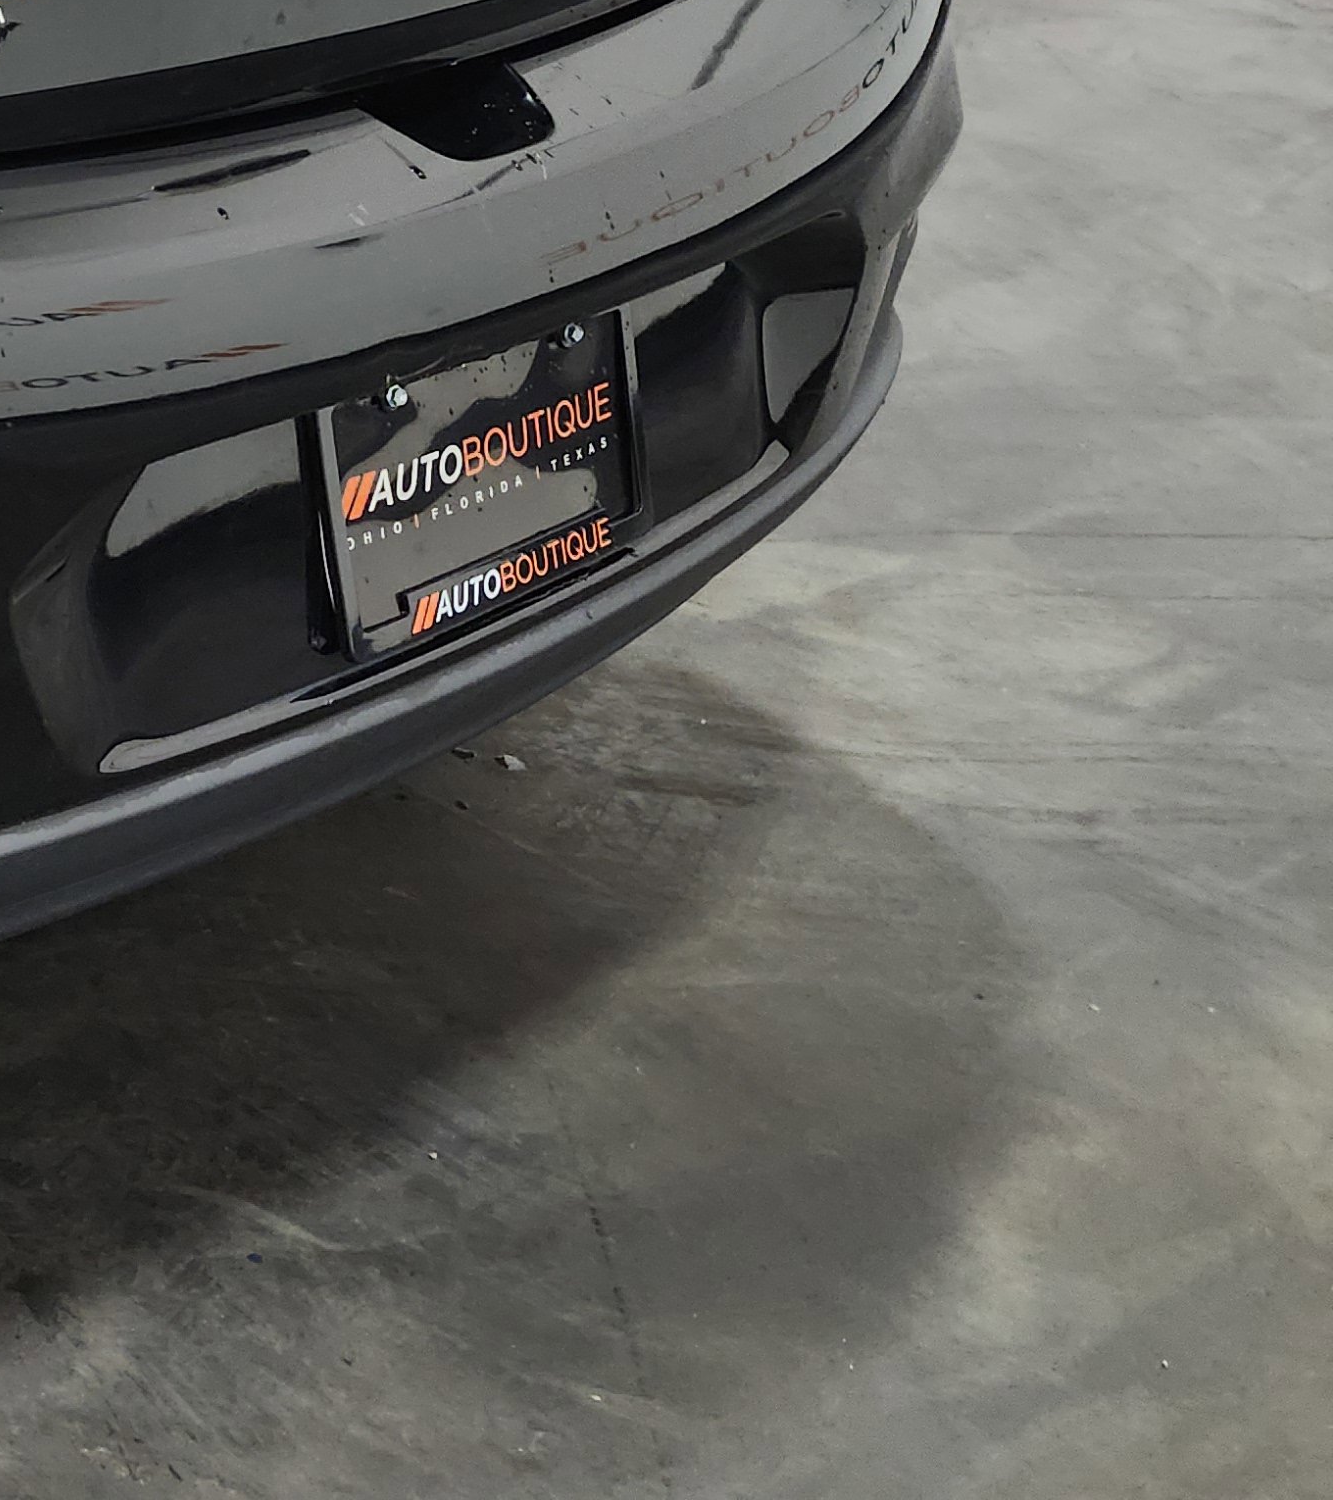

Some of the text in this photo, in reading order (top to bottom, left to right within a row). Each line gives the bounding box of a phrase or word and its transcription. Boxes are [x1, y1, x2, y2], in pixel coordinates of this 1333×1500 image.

[367, 382, 613, 513] AUTOBOUTIQUE
[430, 474, 524, 521] FLORIDA
[550, 436, 608, 472] TEXAS
[435, 517, 613, 623] AUTOBOUTIQUE
